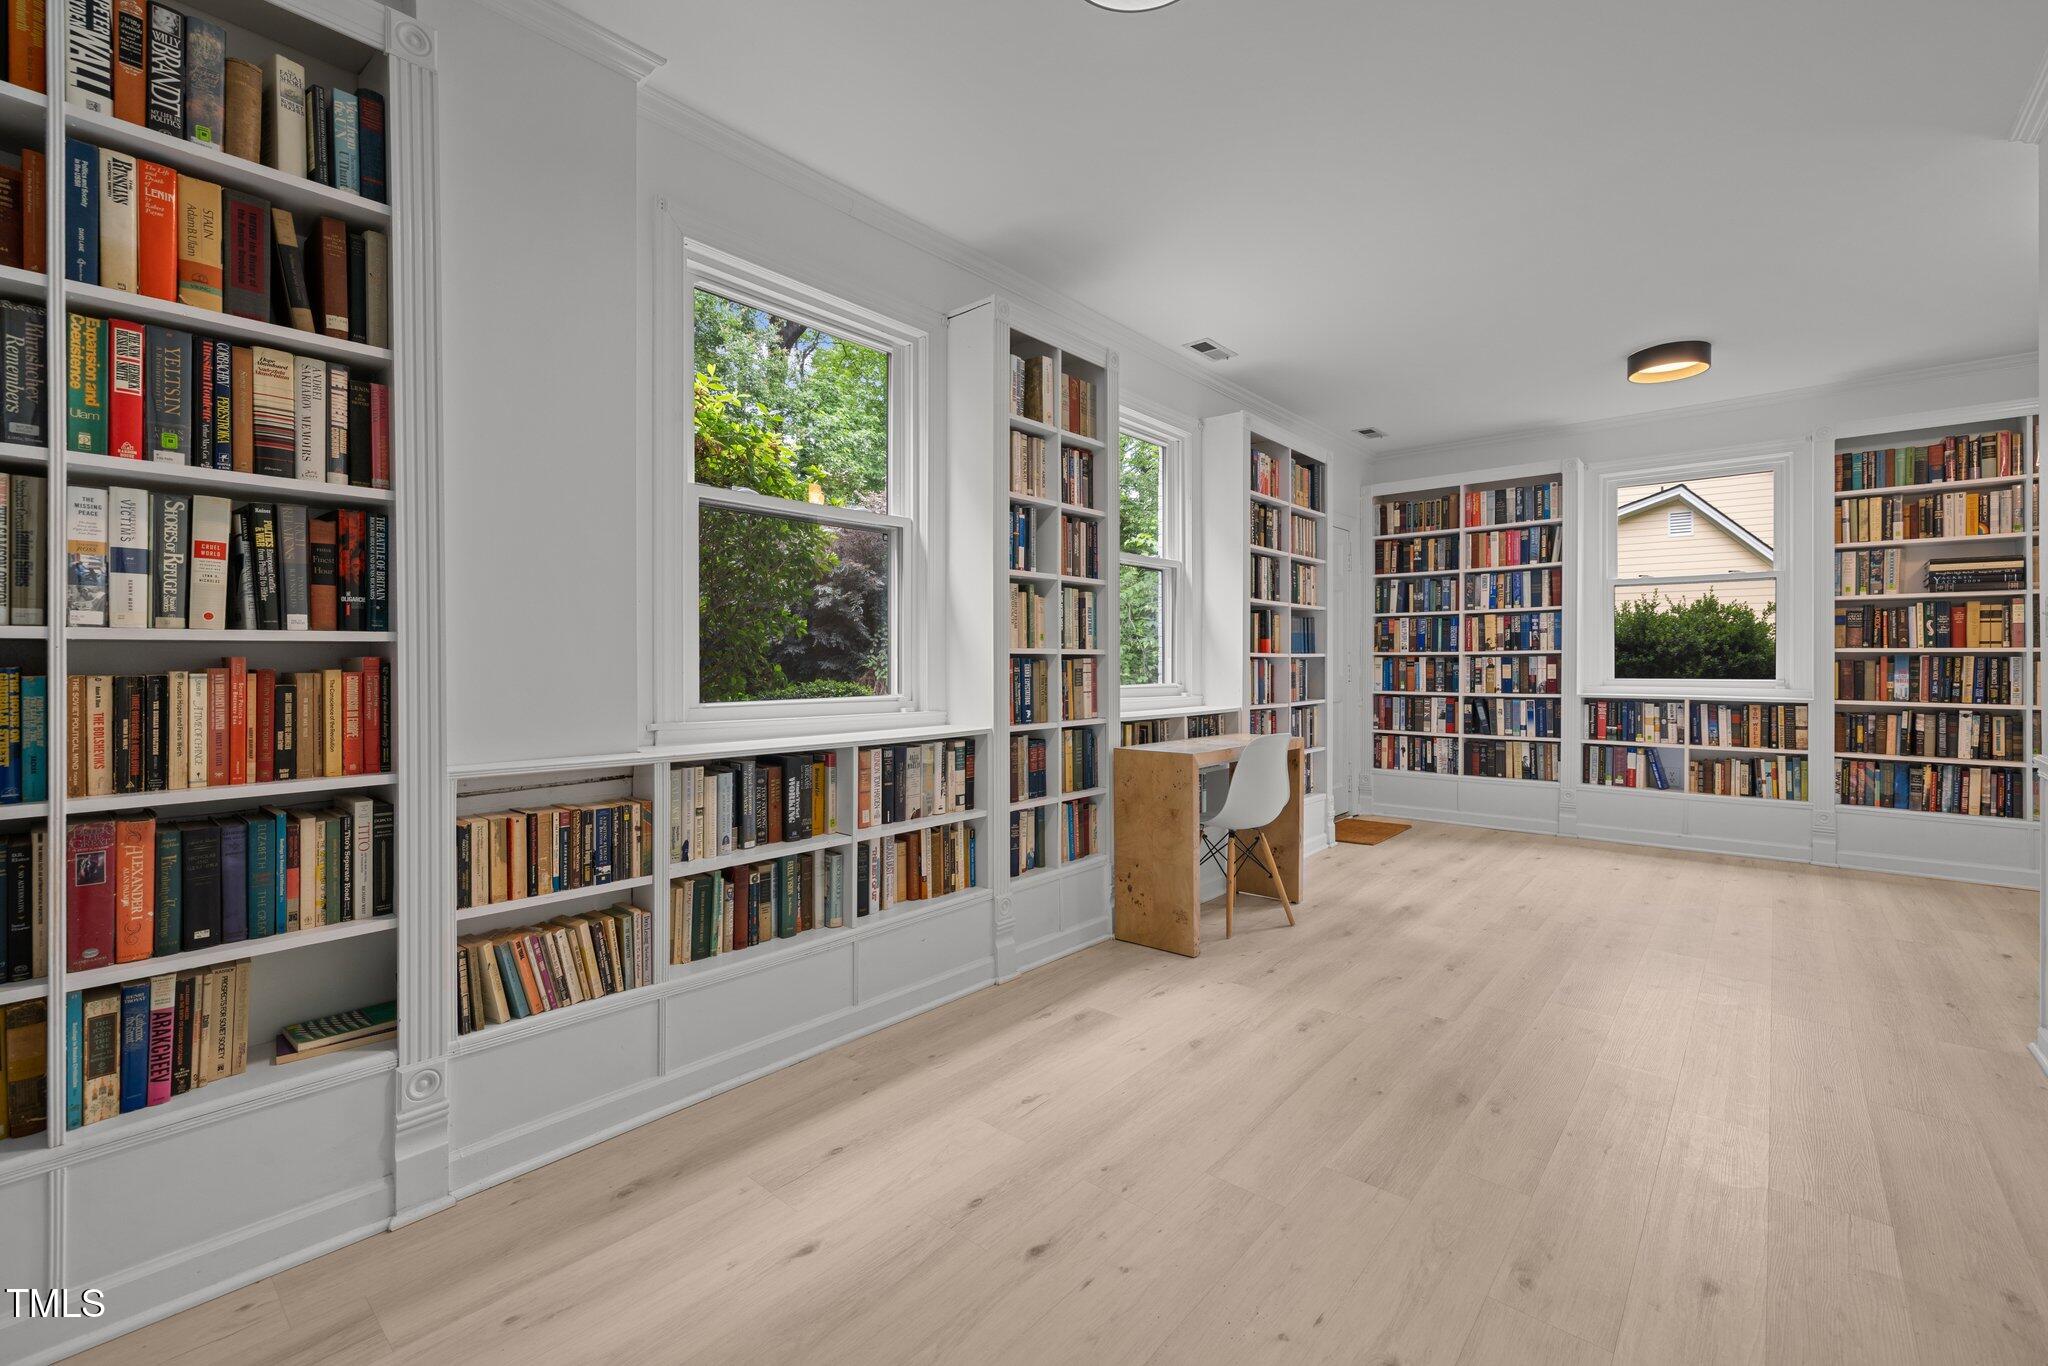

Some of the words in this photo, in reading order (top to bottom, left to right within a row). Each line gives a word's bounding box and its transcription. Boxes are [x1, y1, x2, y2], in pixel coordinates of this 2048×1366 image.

[93, 1, 110, 32] PETER
[152, 30, 181, 50] WILLY
[69, 29, 111, 101] WALL
[151, 40, 181, 117] BRANDT
[151, 114, 181, 129] POLITICS
[346, 100, 357, 124] View
[346, 126, 357, 149] from
[80, 189, 88, 207] Society
[145, 187, 174, 202] LENIN
[187, 202, 198, 229] Adam
[203, 208, 214, 240] STALIN
[187, 234, 198, 257] Ulam
[70, 314, 86, 390] Coexistence
[84, 318, 100, 382] Expansion
[116, 329, 128, 357] RUSSIANS
[130, 333, 140, 346] THE
[130, 346, 140, 357] NEW
[4, 333, 25, 413] Remembers
[24, 321, 44, 404] Khrushchev
[116, 361, 128, 380] SMITH
[202, 341, 213, 382] Russian
[216, 343, 230, 388] GORBACHEV
[130, 363, 140, 389] HEDRICK
[164, 346, 182, 417] YELTSIN
[302, 364, 312, 410] SAKHAROV
[313, 367, 322, 401] ANDREI
[331, 369, 348, 389] THE
[84, 382, 100, 408] and
[202, 383, 213, 422] Roulette
[70, 408, 100, 420] Ulam
[216, 396, 230, 444] PERESTROIKA
[331, 388, 348, 430] THREAT
[302, 414, 312, 462] MEMOIRS
[15, 480, 29, 508] Stephen
[74, 503, 102, 511] MISSING
[15, 508, 27, 530] Green
[120, 499, 132, 543] VICTIMS
[163, 500, 185, 542] SHORES
[376, 516, 385, 533] THE
[14, 530, 32, 560] Taking
[165, 542, 176, 552] OF
[264, 520, 273, 548] POLITICS
[282, 508, 296, 560] RELATIONS
[296, 521, 305, 547] RICH
[376, 534, 385, 559] BATTLE
[258, 560, 266, 576] Philip
[266, 548, 275, 572] European
[312, 555, 334, 564] Finest
[376, 560, 385, 570] OF
[16, 560, 33, 587] Sides
[163, 552, 184, 595] REFUGE
[268, 573, 276, 593] Conflict
[376, 572, 385, 600] BRITAIN
[260, 587, 268, 601] Hitler
[289, 568, 298, 608] REYNOLDS
[347, 718, 358, 738] EUROPE
[788, 776, 796, 824] WORKING
[258, 824, 266, 869] ELIZABETH
[358, 823, 370, 852] TITO
[122, 867, 130, 884] ALAN
[126, 845, 144, 913] ALEXANDER
[122, 885, 130, 907] PALMER
[258, 890, 266, 908] THE
[258, 911, 266, 935] GREAT
[220, 1006, 228, 1018] FOR
[134, 1014, 145, 1042] Catherine
[219, 1018, 227, 1037] SOVIET
[150, 1012, 172, 1084] ARAKCHEEV
[217, 1037, 225, 1059] SOCIETY
